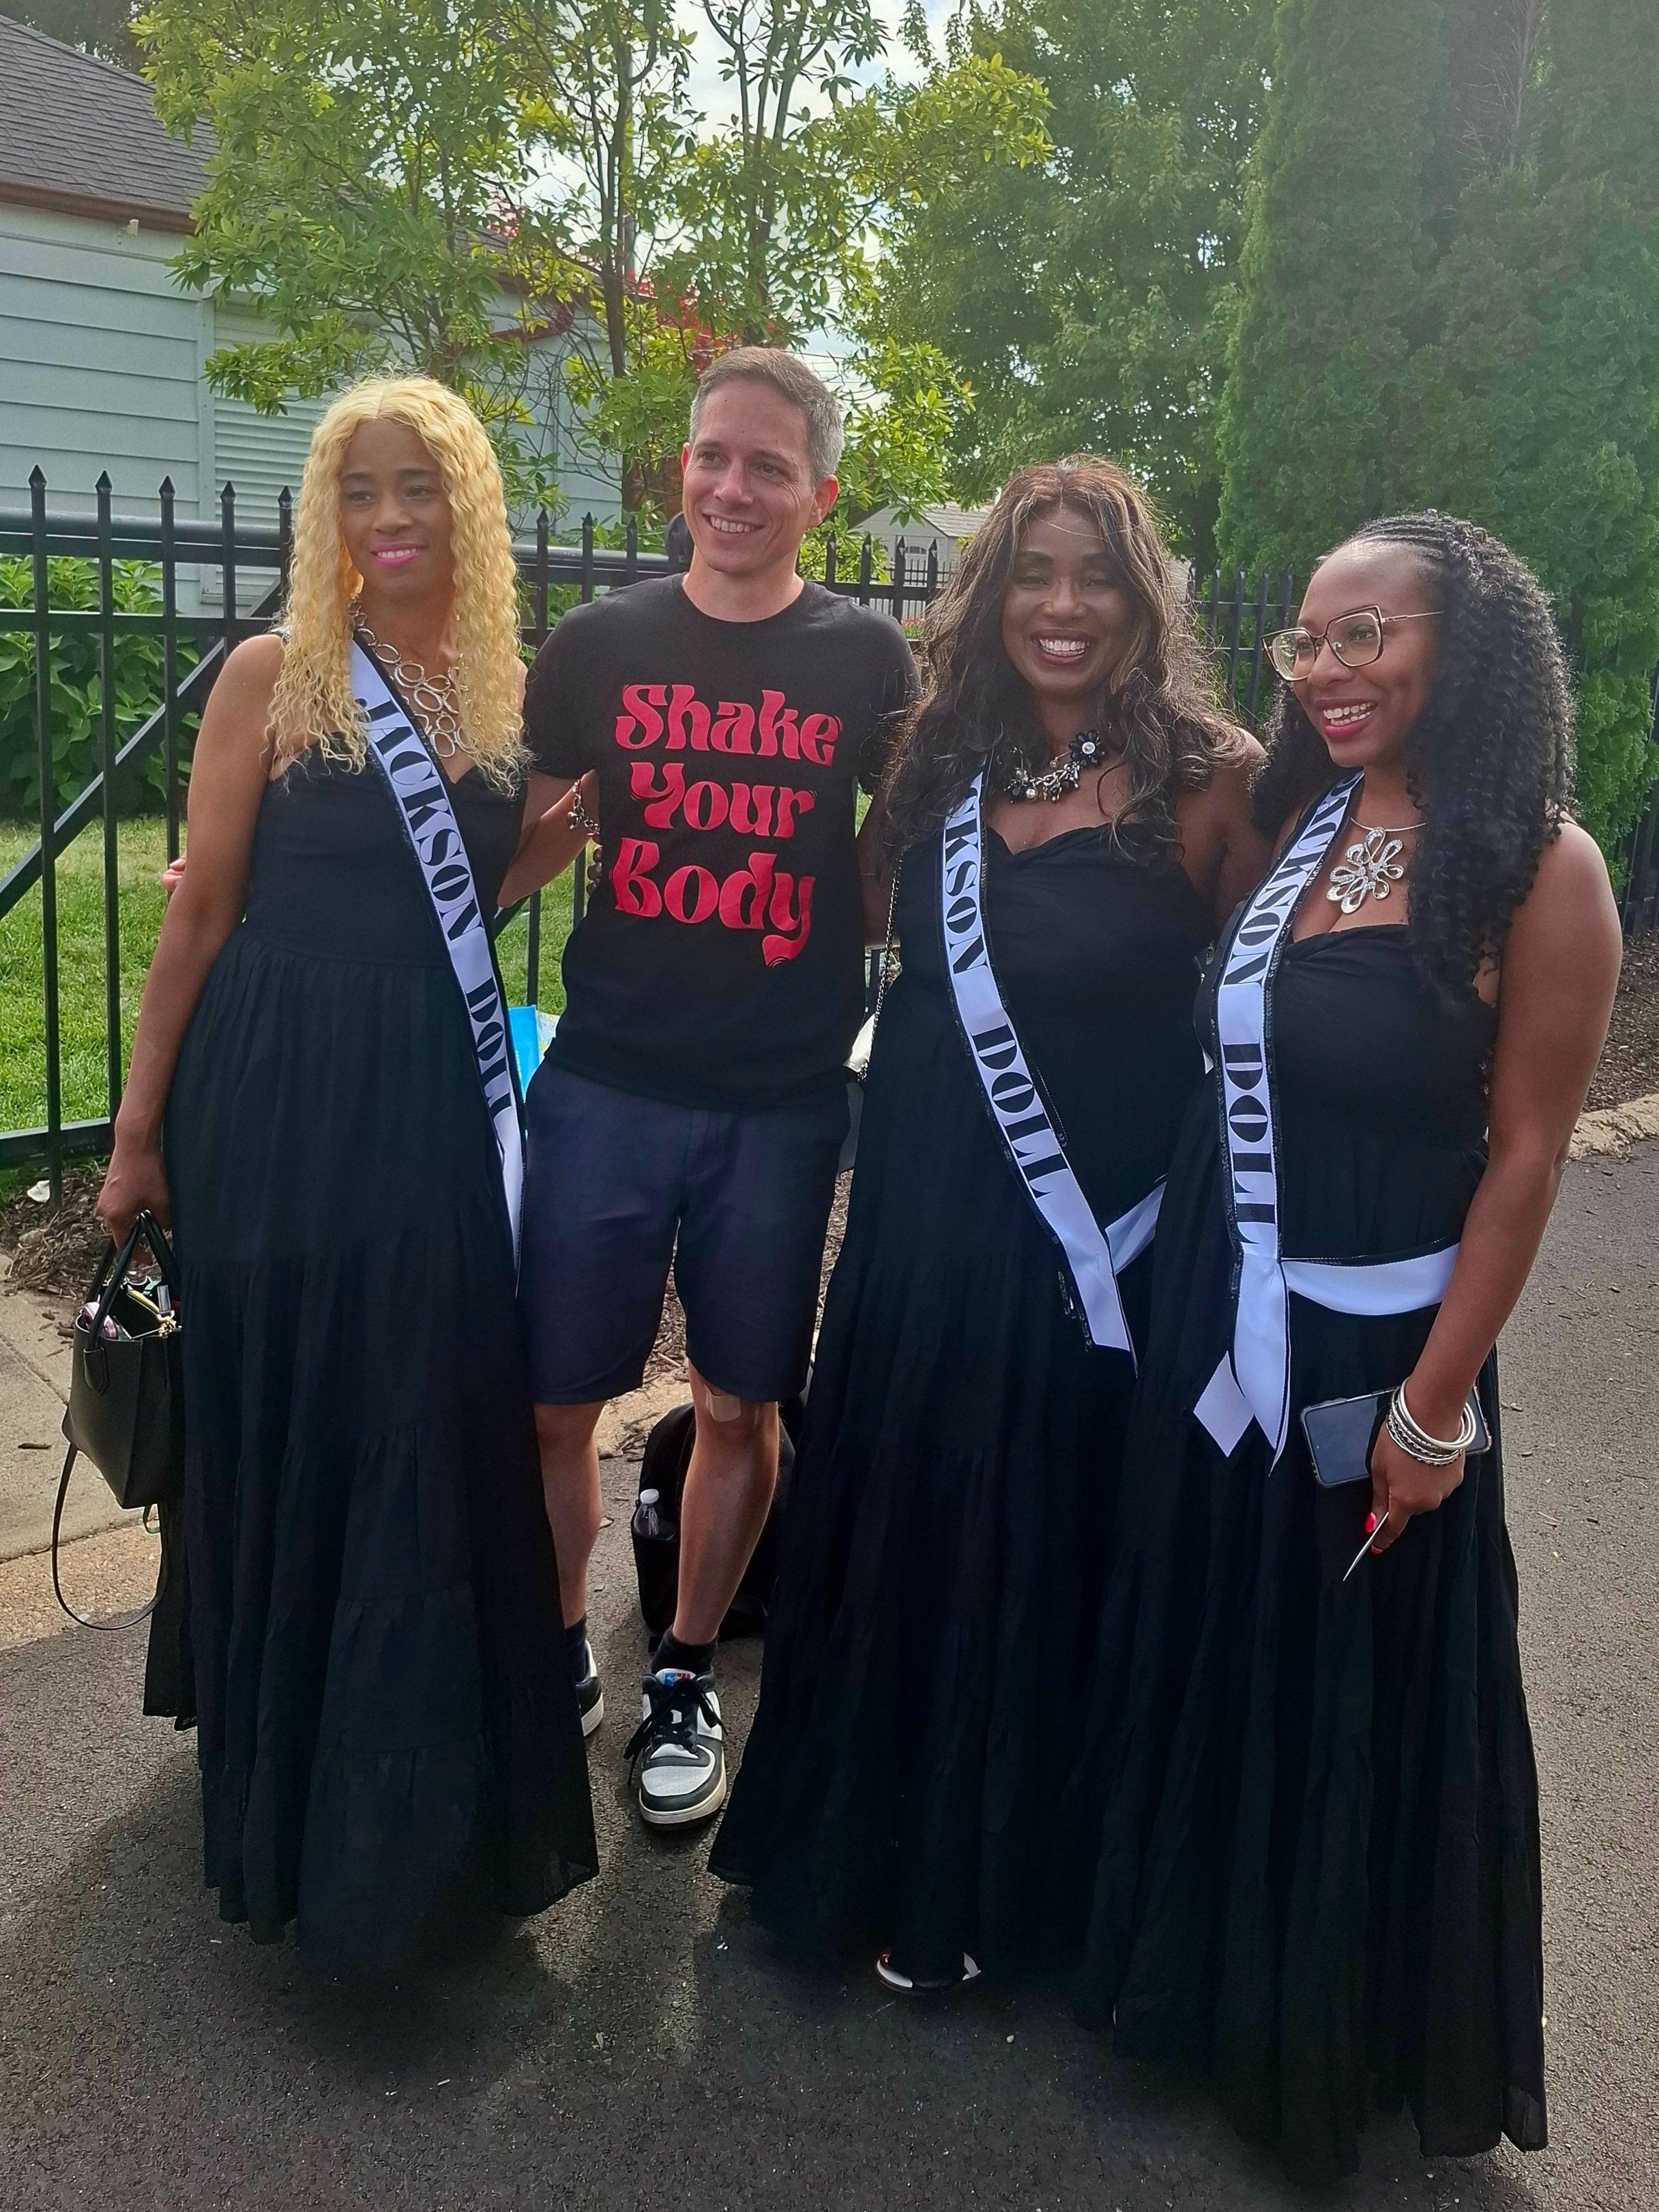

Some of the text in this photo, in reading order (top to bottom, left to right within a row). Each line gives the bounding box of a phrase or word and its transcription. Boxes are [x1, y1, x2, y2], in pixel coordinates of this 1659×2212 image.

[615, 684, 842, 767] Shake
[630, 762, 817, 838] Your
[353, 696, 514, 1122] JACKSON DOLL
[610, 838, 817, 967] Body
[969, 1020, 1070, 1199] DOLL
[1221, 1037, 1277, 1245] DOLL
